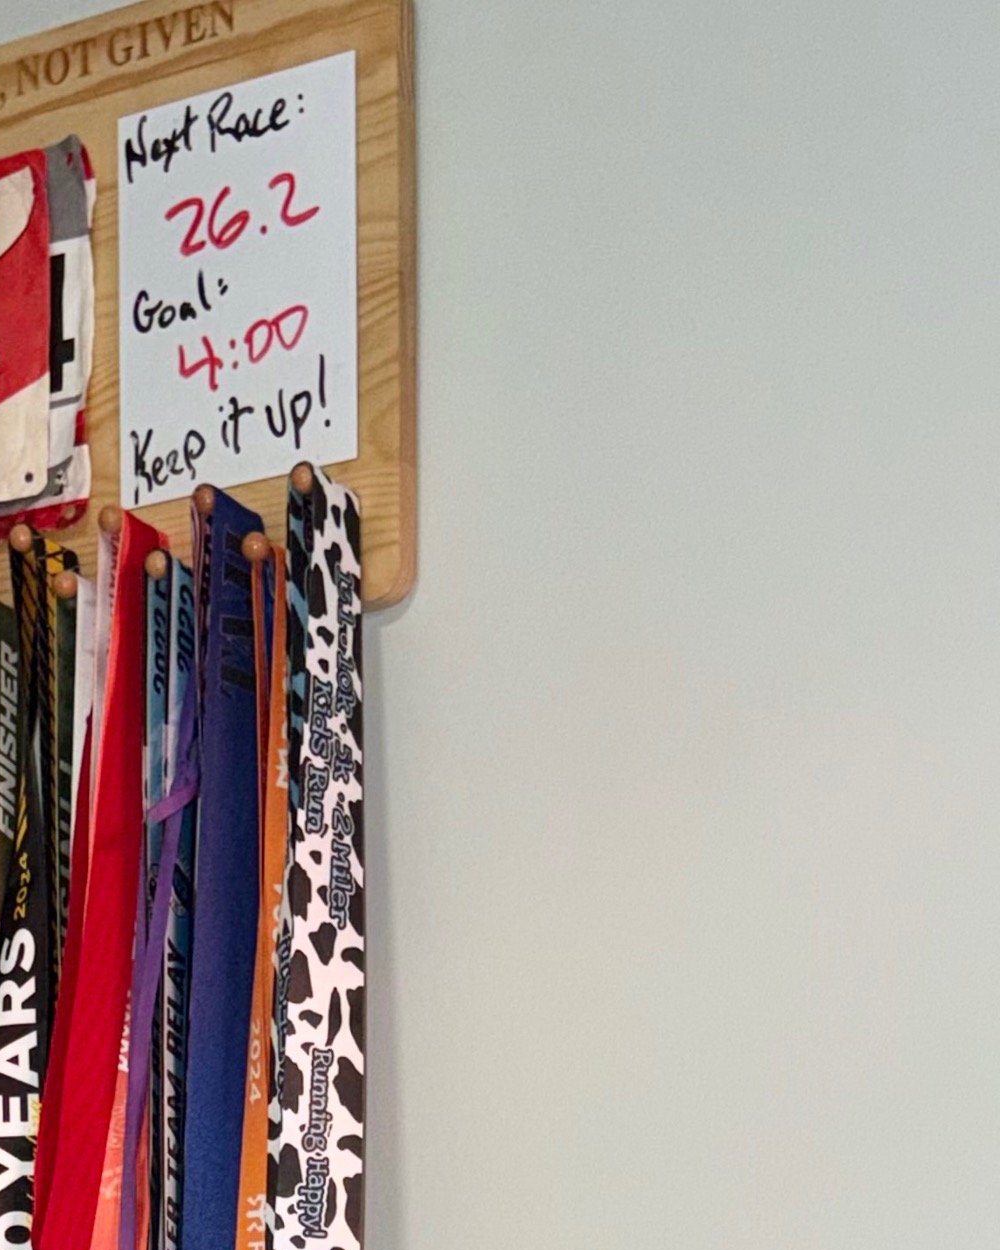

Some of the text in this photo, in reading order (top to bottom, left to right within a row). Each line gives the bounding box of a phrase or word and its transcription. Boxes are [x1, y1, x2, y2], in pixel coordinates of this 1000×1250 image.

[14, 36, 100, 96] NOT
[105, 2, 235, 66] GIVEN
[125, 92, 304, 184] Next Race:
[164, 171, 320, 257] 26.2
[133, 268, 229, 333] Goal:
[178, 304, 309, 392] 4:00
[130, 429, 205, 505] Keep
[218, 396, 254, 454] it
[304, 676, 333, 836] Kids Run
[13, 851, 30, 921] 2024
[329, 839, 354, 931] Miler
[249, 1019, 263, 1104] 2024
[297, 1046, 335, 1241] Running Happy!
